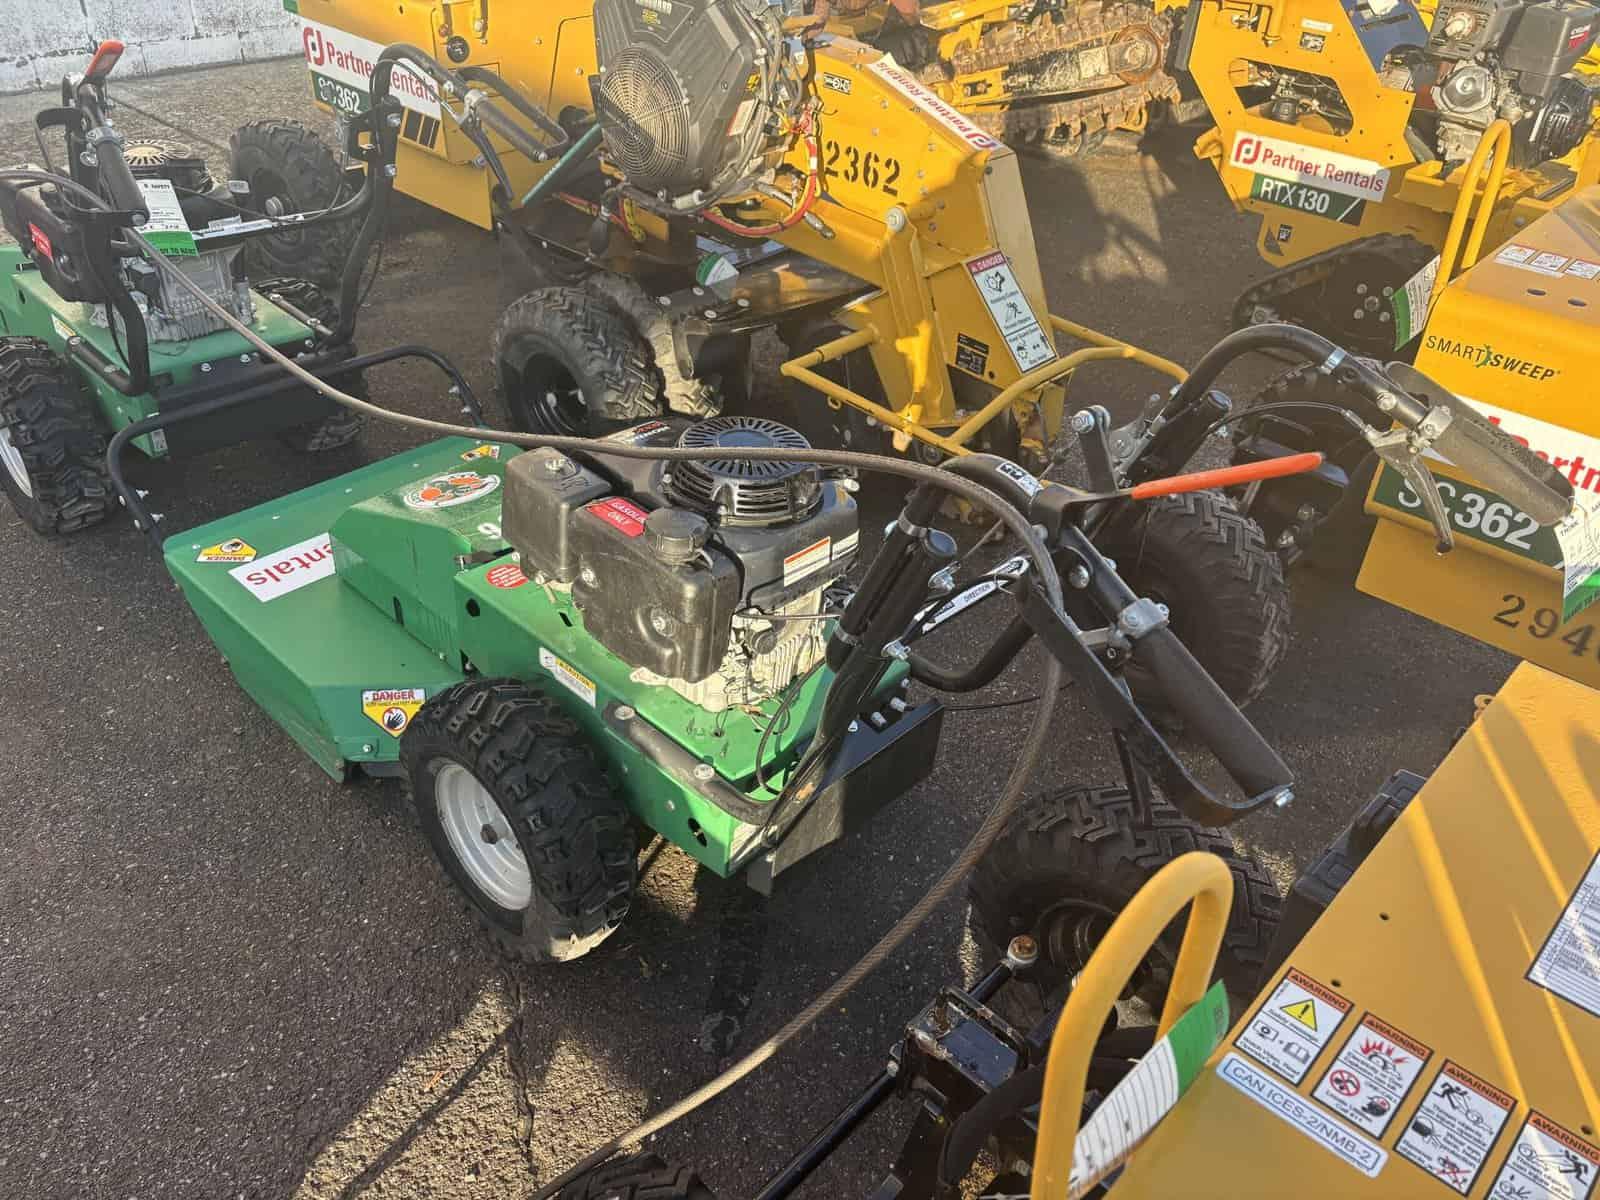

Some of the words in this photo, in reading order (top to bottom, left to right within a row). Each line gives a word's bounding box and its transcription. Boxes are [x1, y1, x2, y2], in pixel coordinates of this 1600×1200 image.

[326, 40, 378, 77] Partne
[392, 71, 437, 104] entals
[824, 140, 901, 197] 2362
[1262, 148, 1321, 178] Partner
[1323, 163, 1384, 192] Rentals
[1493, 593, 1600, 664] 294
[372, 690, 415, 701] DANGER
[1296, 977, 1347, 1009] WARNING
[1373, 1021, 1426, 1057] WARNING
[1454, 1069, 1510, 1107] WARNING
[1232, 1066, 1266, 1094] CAN
[1266, 1088, 1373, 1163] ICES-2/NMB-2
[1539, 1120, 1598, 1159] WARNING
